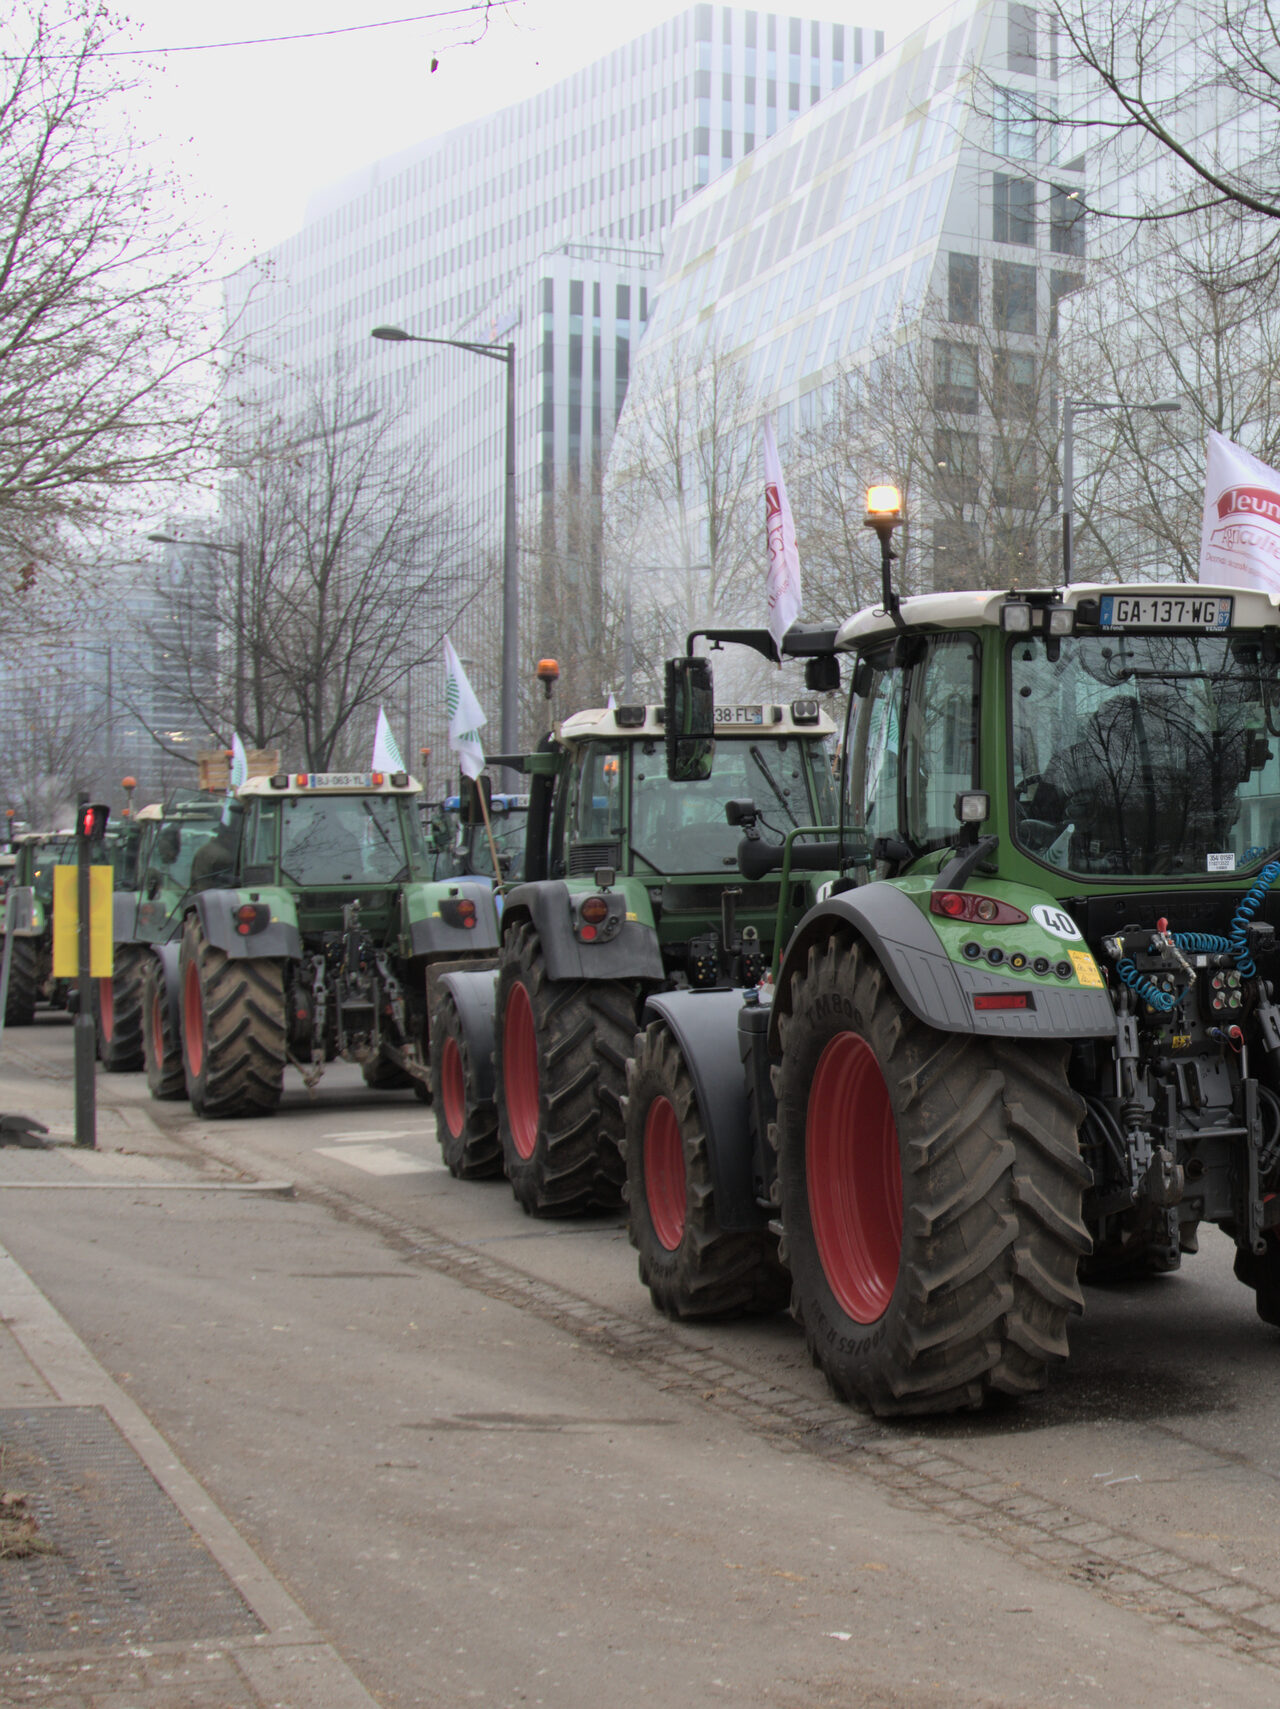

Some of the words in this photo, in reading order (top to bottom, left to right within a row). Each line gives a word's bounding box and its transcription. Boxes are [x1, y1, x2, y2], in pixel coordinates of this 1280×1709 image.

[1116, 600, 1216, 623] GA-137-WG
[1218, 613, 1230, 624] 67
[714, 707, 753, 722] 38-FL
[1041, 909, 1076, 935] 40
